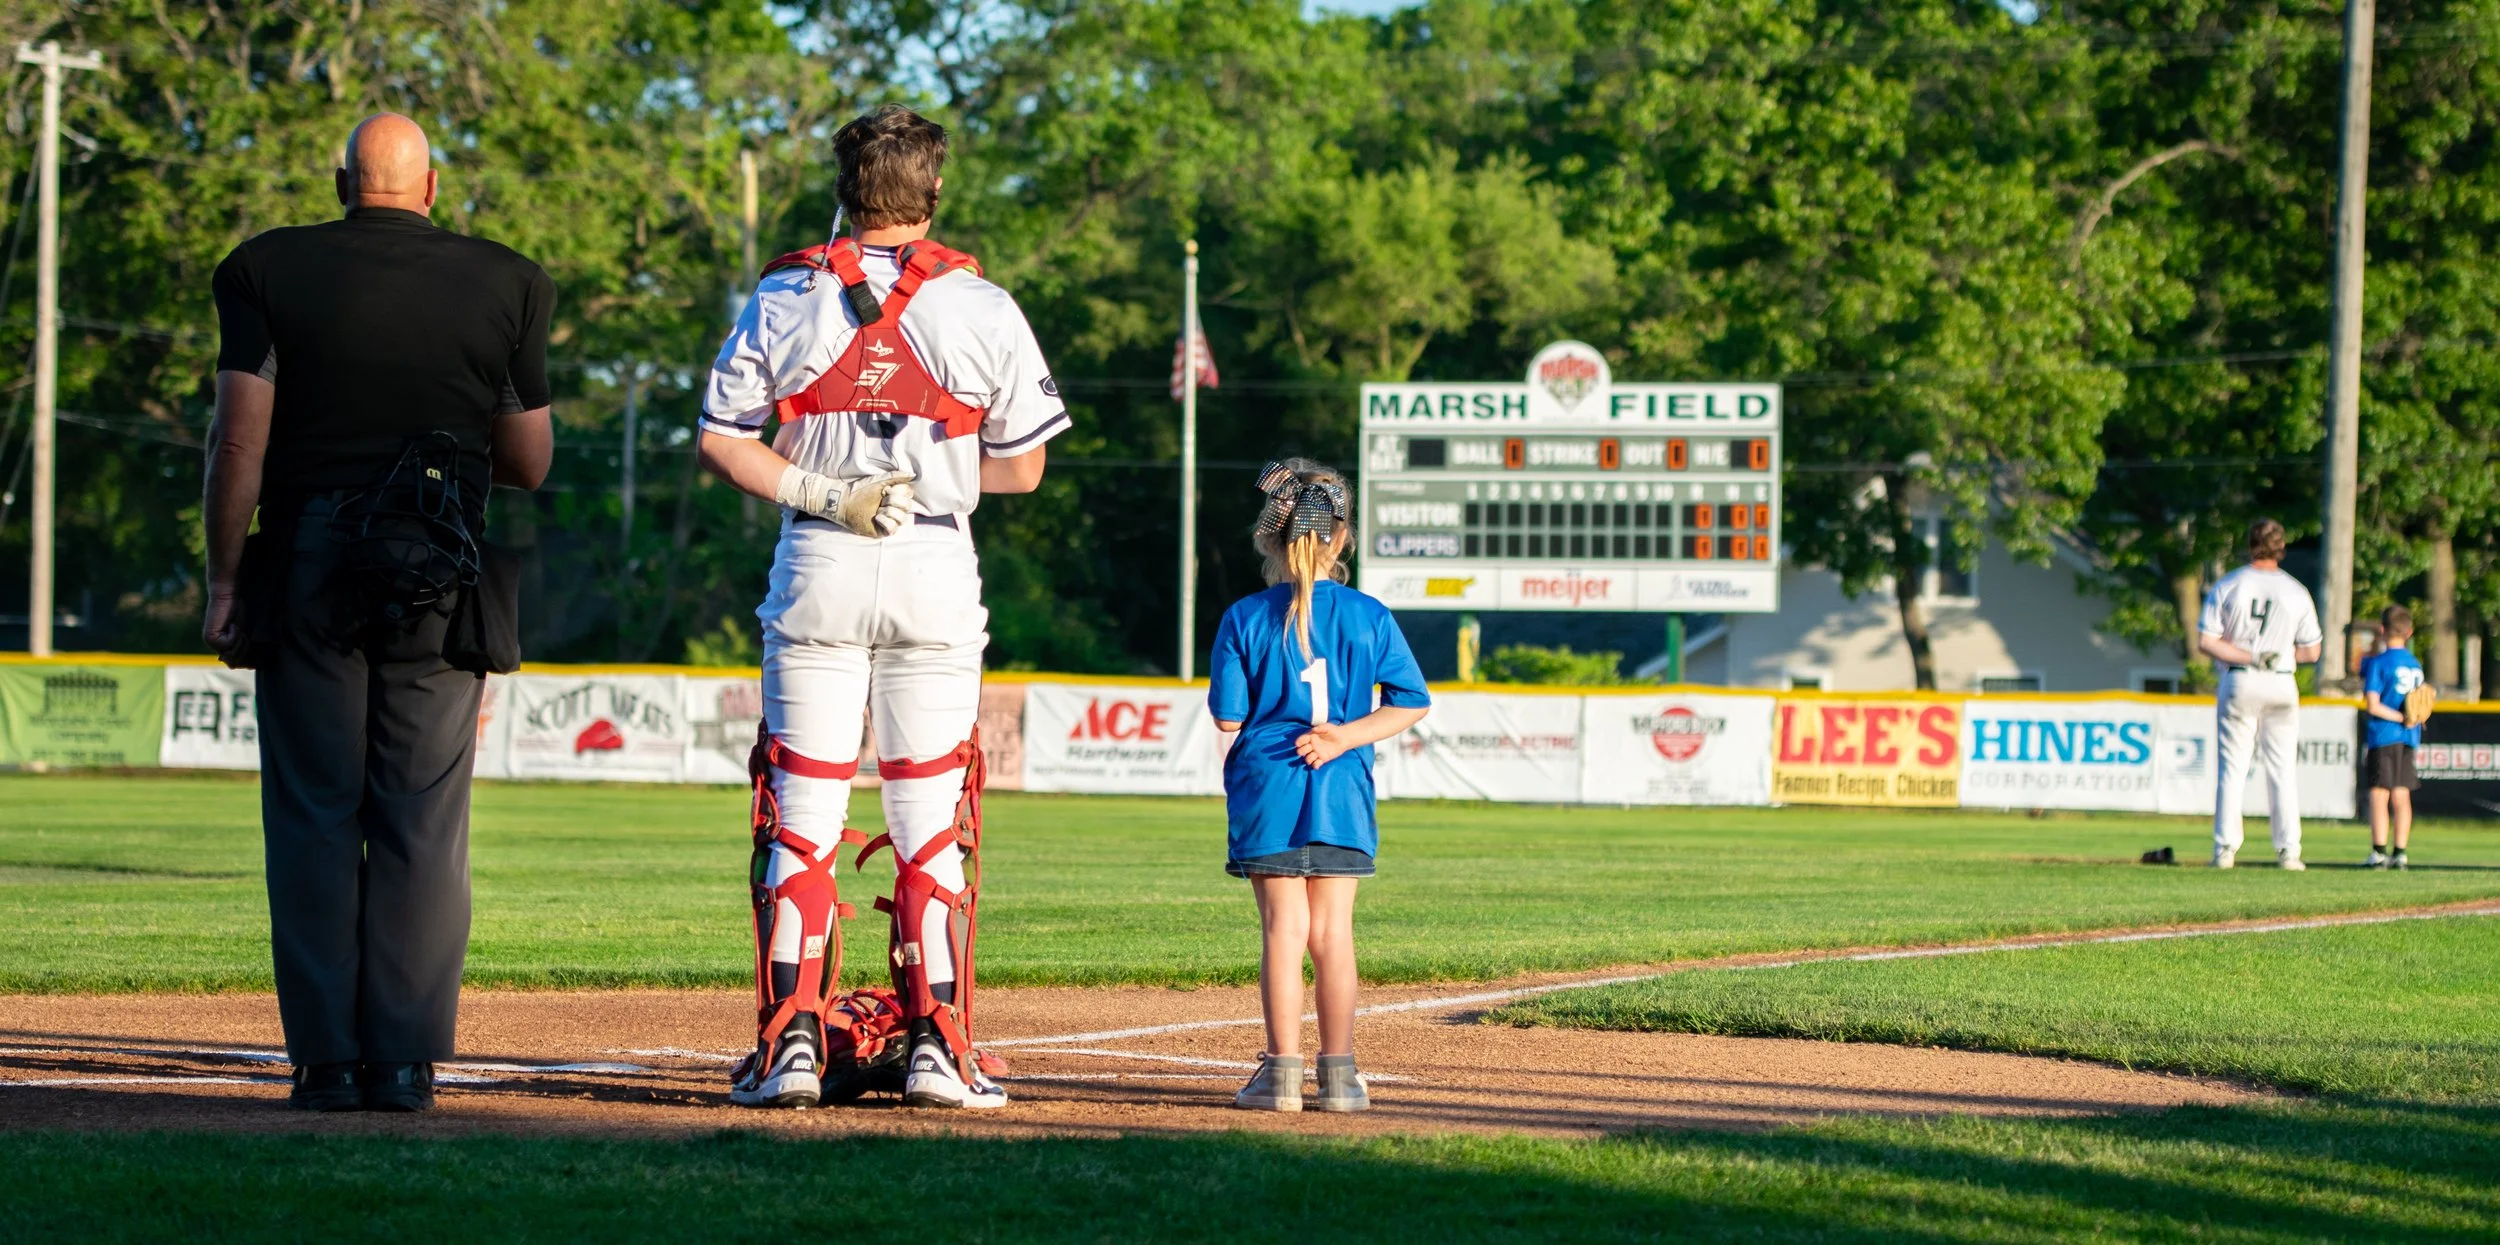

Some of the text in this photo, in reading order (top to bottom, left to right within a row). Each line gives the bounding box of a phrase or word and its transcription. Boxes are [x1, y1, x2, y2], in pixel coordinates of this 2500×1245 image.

[1369, 393, 1770, 418] MARSH FIELD
[1452, 442, 1503, 465] BALL
[1528, 442, 1598, 465] STRIKE
[1624, 442, 1666, 465] OUT
[1466, 482, 1478, 501] 1
[1488, 482, 1500, 501] 2
[1508, 482, 1521, 501] 3
[1530, 482, 1543, 501] 4
[1376, 503, 1460, 527] VISITOR
[1376, 533, 1459, 556] CLIPPERS
[1522, 569, 1611, 608] meijer
[2250, 599, 2272, 634] 4
[1300, 657, 1329, 725] 1
[526, 680, 594, 732] SCOTT
[1068, 697, 1173, 741] ACE
[1777, 704, 1958, 766] LEE'S
[1970, 719, 2151, 764] HINES
[1066, 745, 1168, 761] Hardware
[1837, 773, 1887, 800] Recipe
[1896, 774, 1955, 798] Chicken
[1969, 770, 2152, 792] CORPORATION
[792, 1060, 812, 1070] NIKE
[914, 1060, 934, 1071] NIKE
